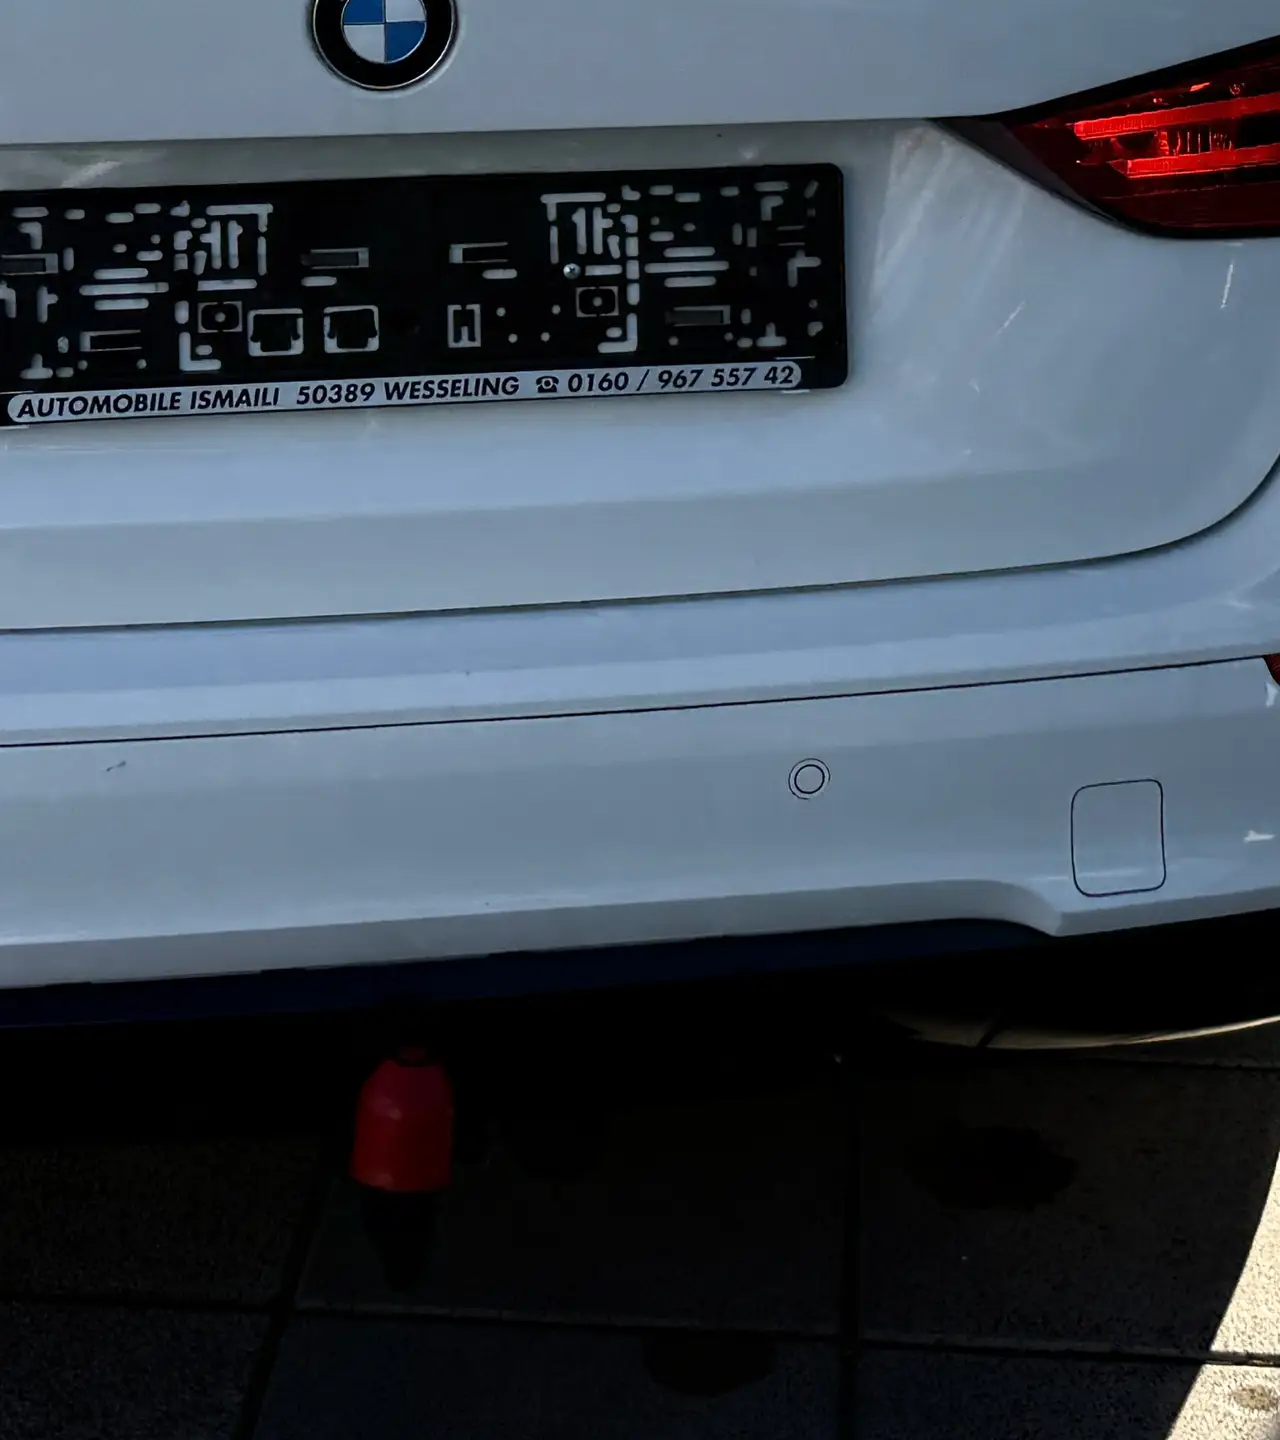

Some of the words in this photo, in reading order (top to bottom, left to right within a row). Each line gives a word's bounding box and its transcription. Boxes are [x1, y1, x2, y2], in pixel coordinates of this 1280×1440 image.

[17, 391, 182, 418] AUTOMOBILE
[190, 387, 280, 411] ISMAILI
[296, 383, 376, 405] 50389
[384, 376, 520, 401] WESSELING
[568, 371, 629, 393] 0160
[636, 368, 650, 391] /
[657, 369, 704, 389] 967
[711, 366, 757, 386] 557
[764, 365, 795, 385] 42
